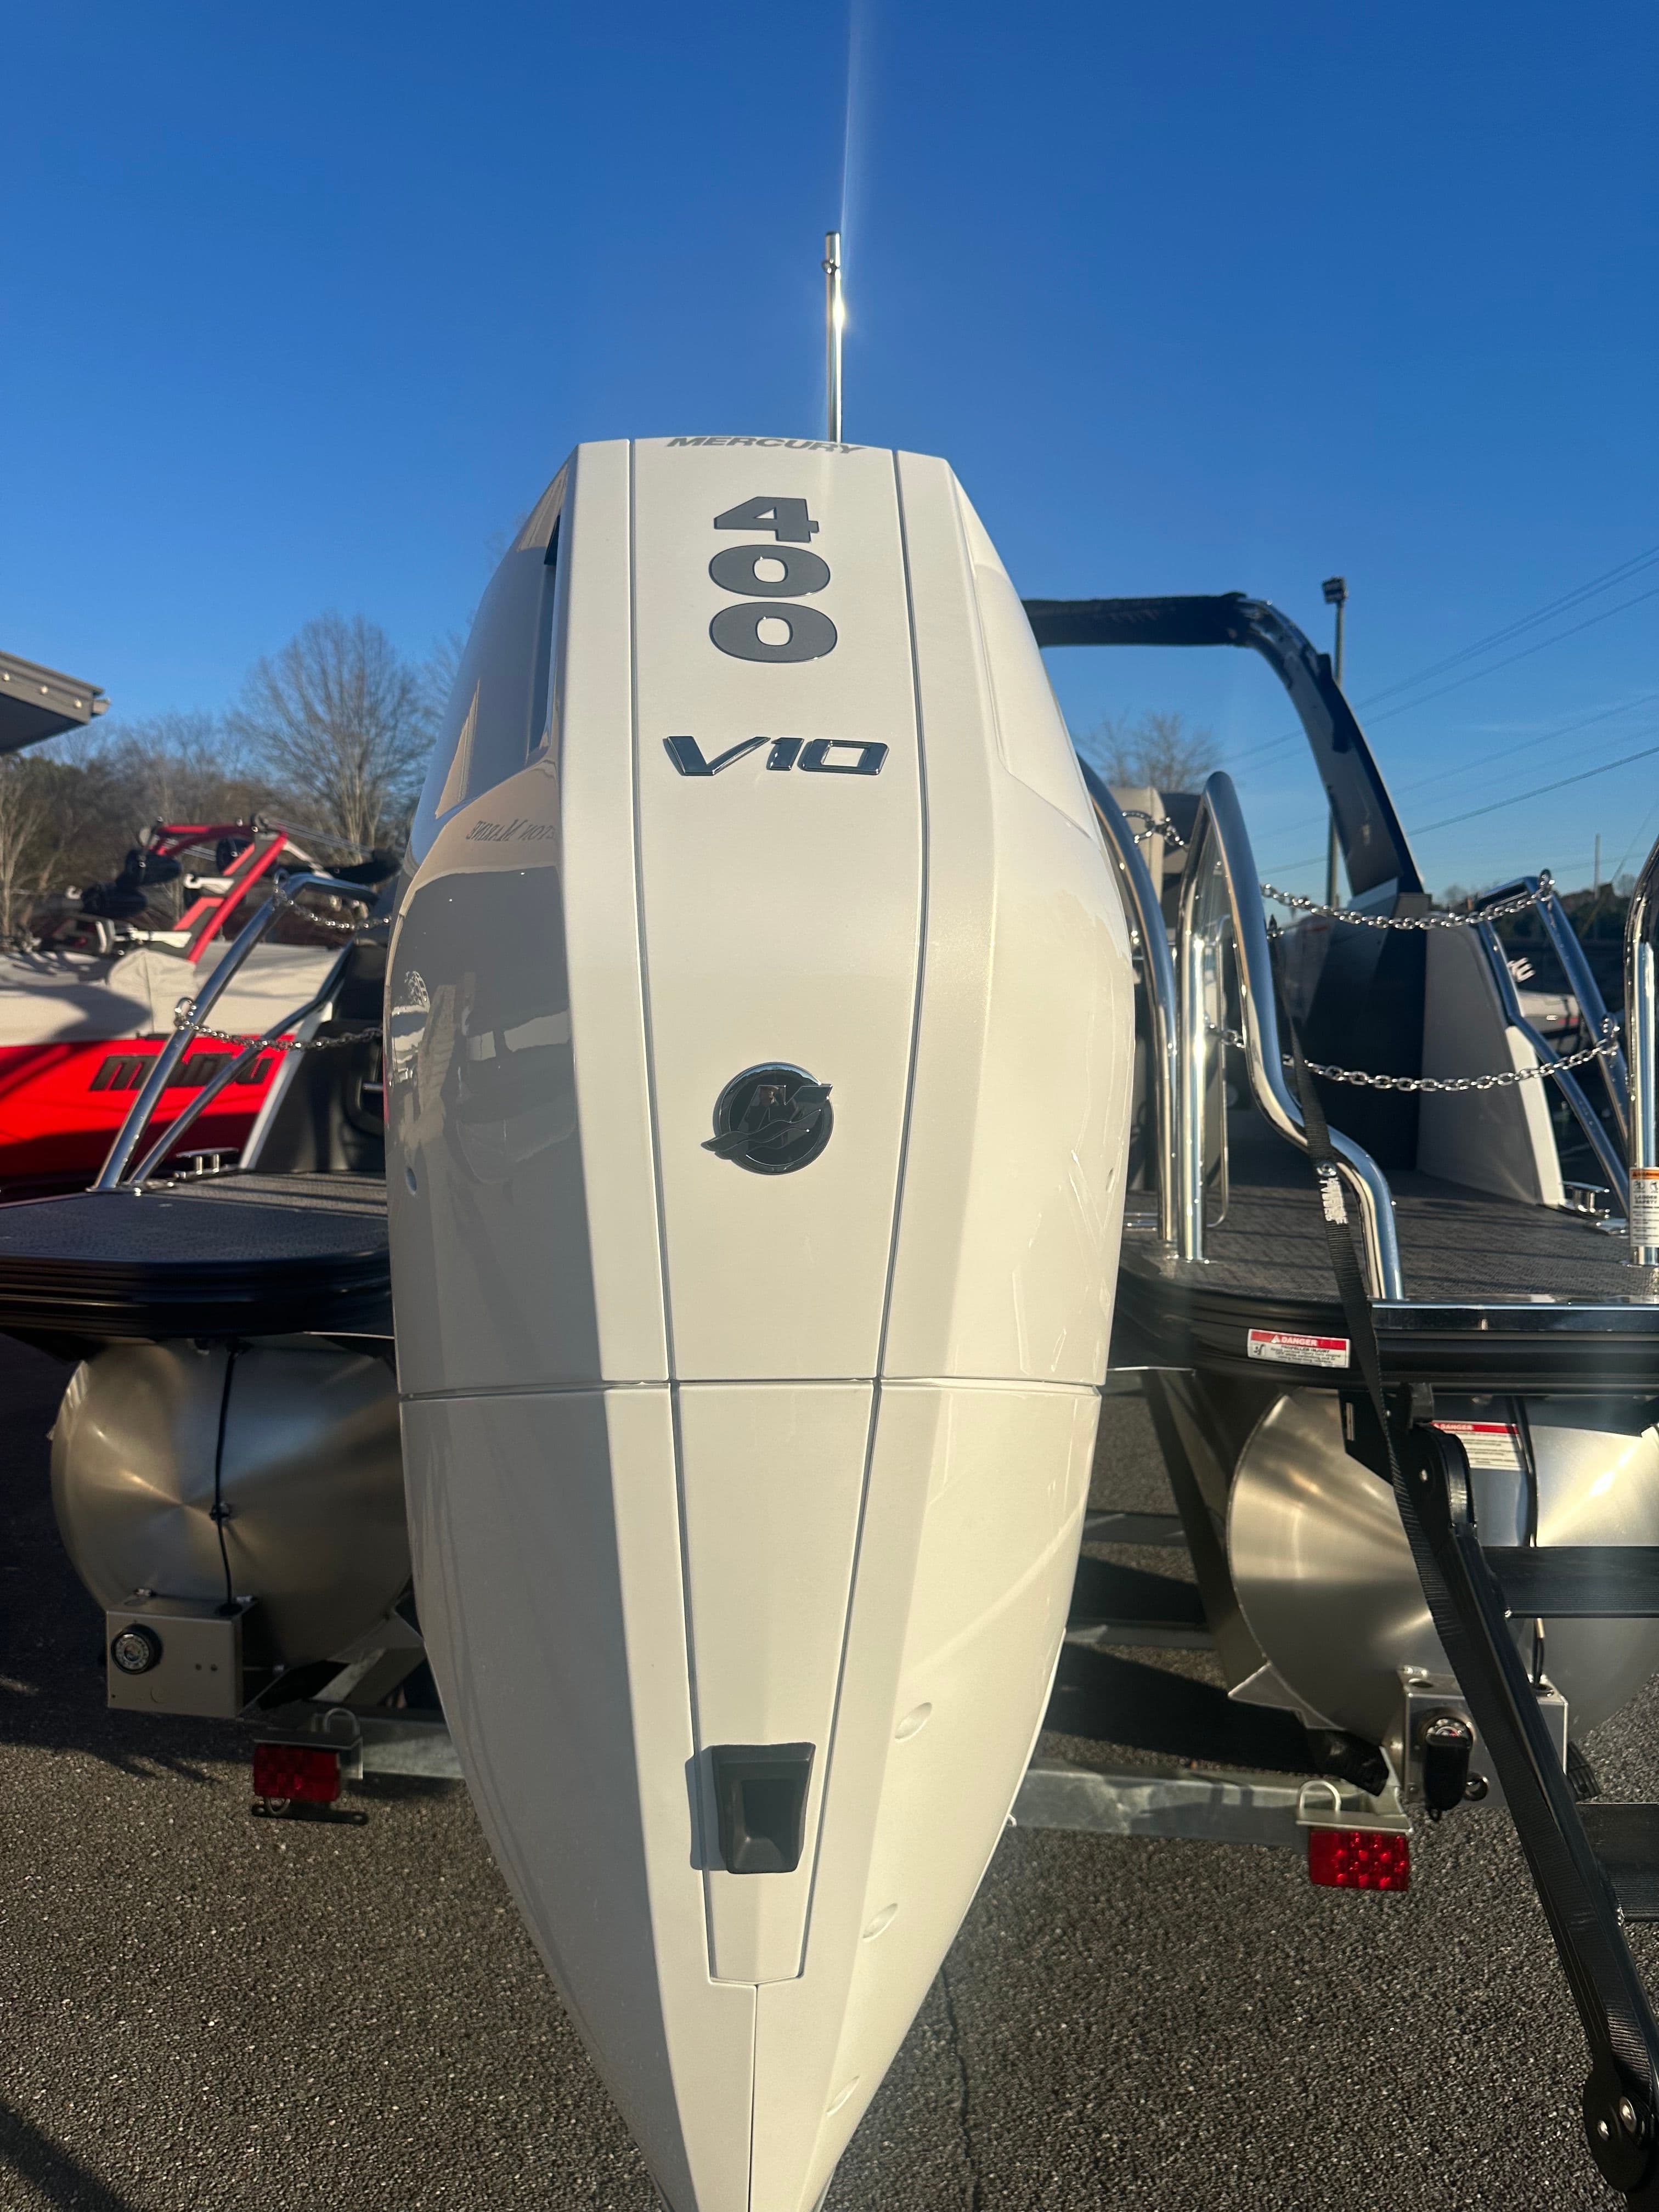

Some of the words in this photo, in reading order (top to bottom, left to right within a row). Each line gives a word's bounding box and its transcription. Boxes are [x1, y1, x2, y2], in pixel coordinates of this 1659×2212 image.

[665, 437, 869, 454] MERCURY
[709, 496, 838, 663] 400
[663, 736, 889, 776] V10
[1281, 1336, 1318, 1346] DANGER
